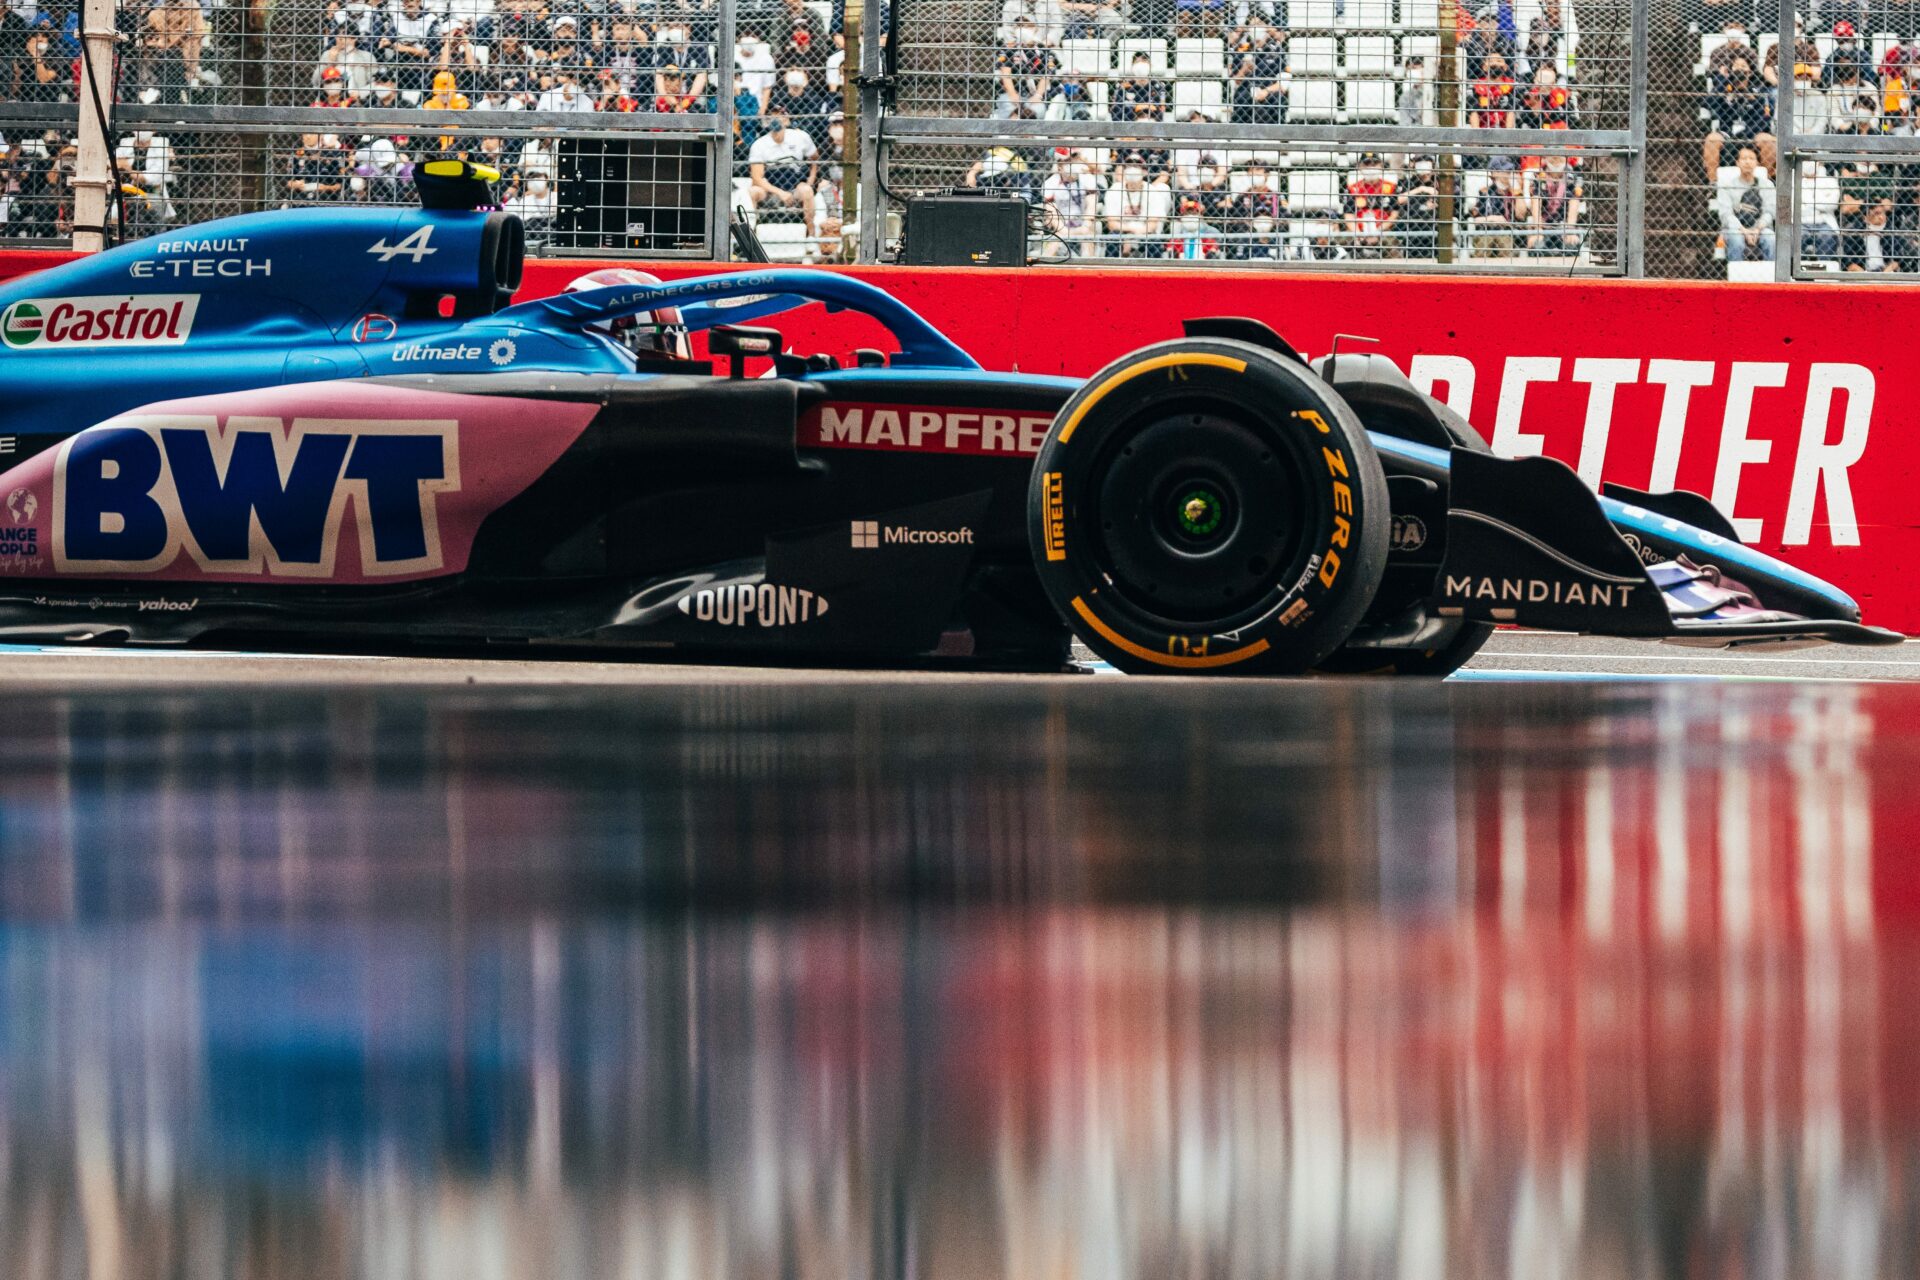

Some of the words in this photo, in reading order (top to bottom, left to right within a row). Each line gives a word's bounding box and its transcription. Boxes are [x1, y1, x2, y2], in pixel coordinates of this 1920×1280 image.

[157, 238, 249, 253] RENAULT
[130, 258, 271, 278] E-TECH
[608, 276, 775, 307] ALPINECARS.COM
[45, 301, 184, 342] Castrol
[392, 343, 482, 362] ultimate
[820, 407, 1055, 451] MAPFRE
[64, 427, 446, 564] BWT
[1297, 410, 1331, 434] P
[1319, 447, 1353, 589] ZERO
[1043, 472, 1066, 561] PIRELLI
[884, 526, 974, 544] Microsoft
[138, 597, 199, 611] yahoo!
[696, 583, 814, 627] DUPONT
[1446, 575, 1636, 608] MANDIANT
